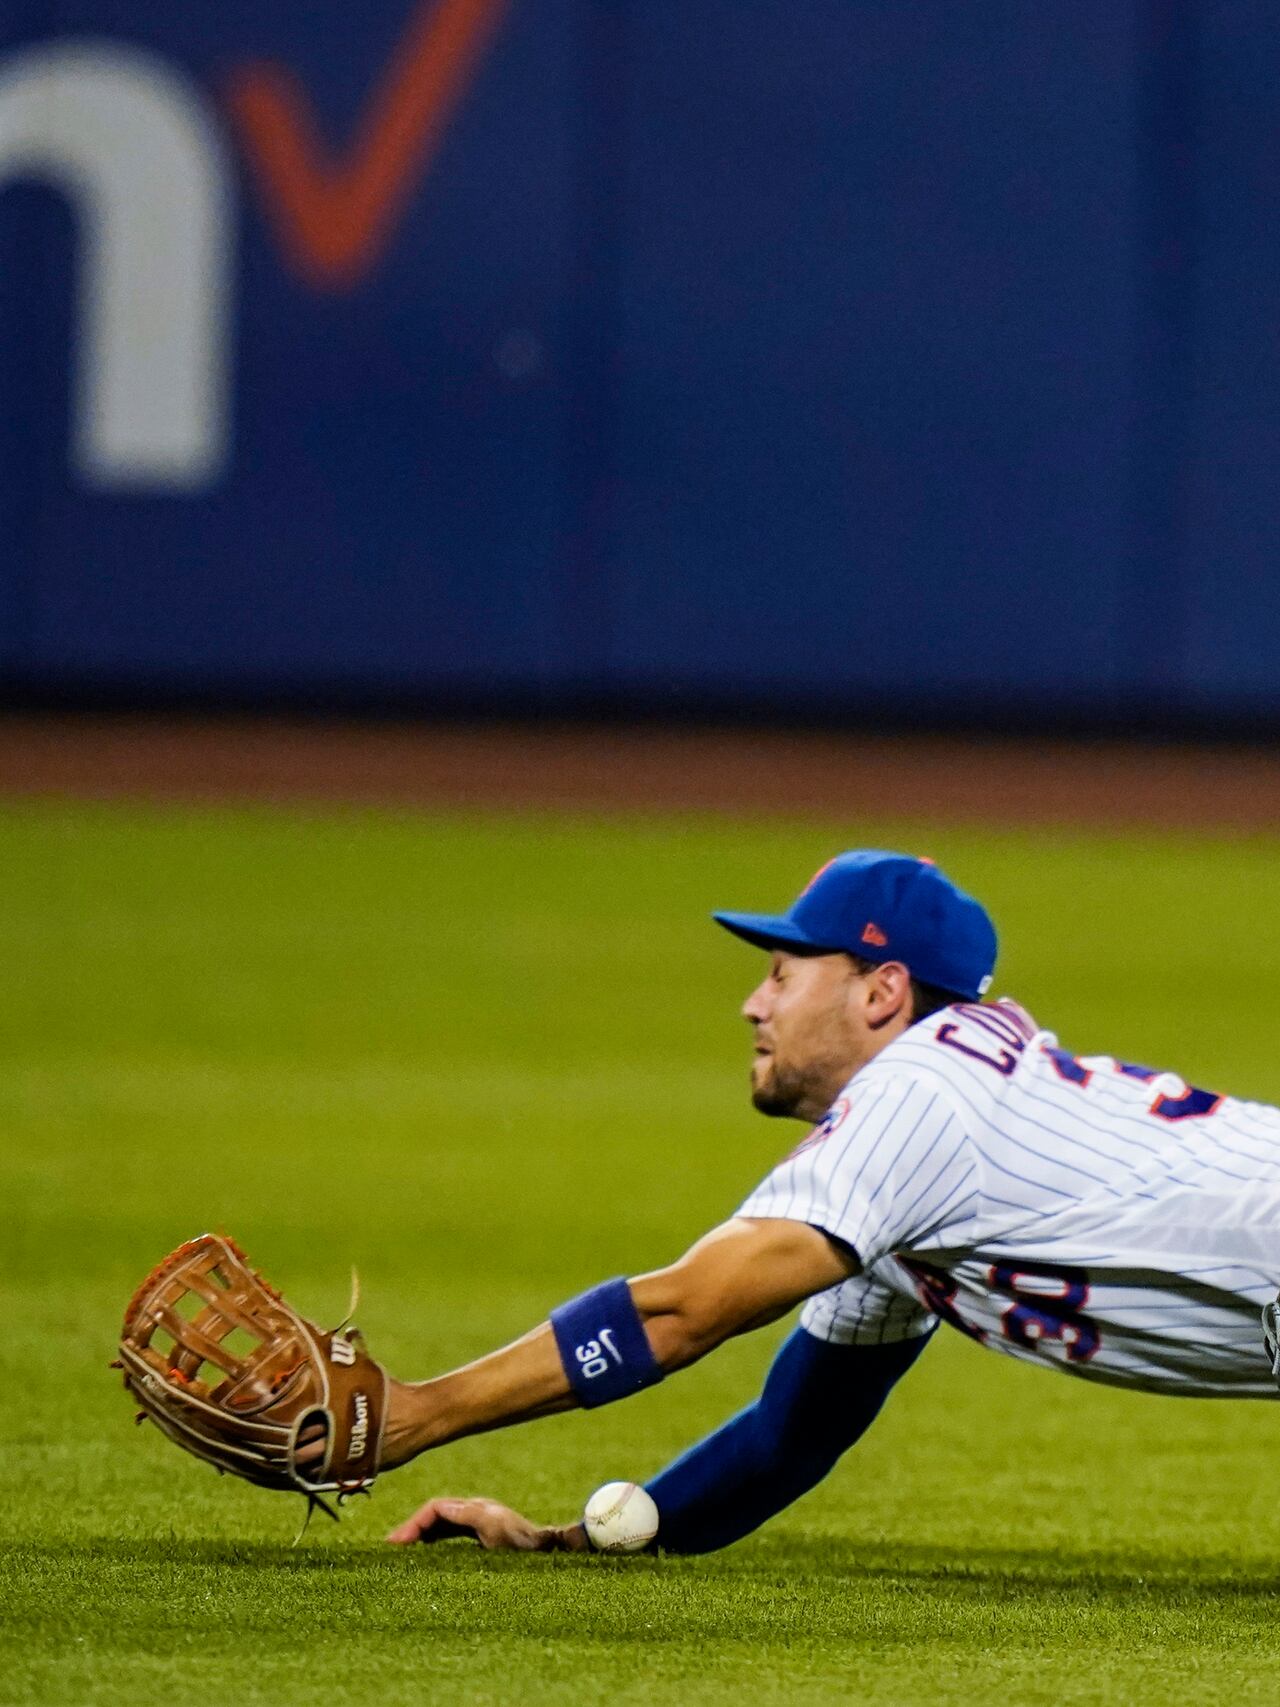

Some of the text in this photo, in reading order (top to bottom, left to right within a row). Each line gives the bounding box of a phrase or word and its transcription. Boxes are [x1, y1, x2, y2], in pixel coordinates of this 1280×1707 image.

[987, 1256, 1102, 1364] 30
[574, 1340, 608, 1378] 30
[346, 1394, 369, 1461] Wilson
